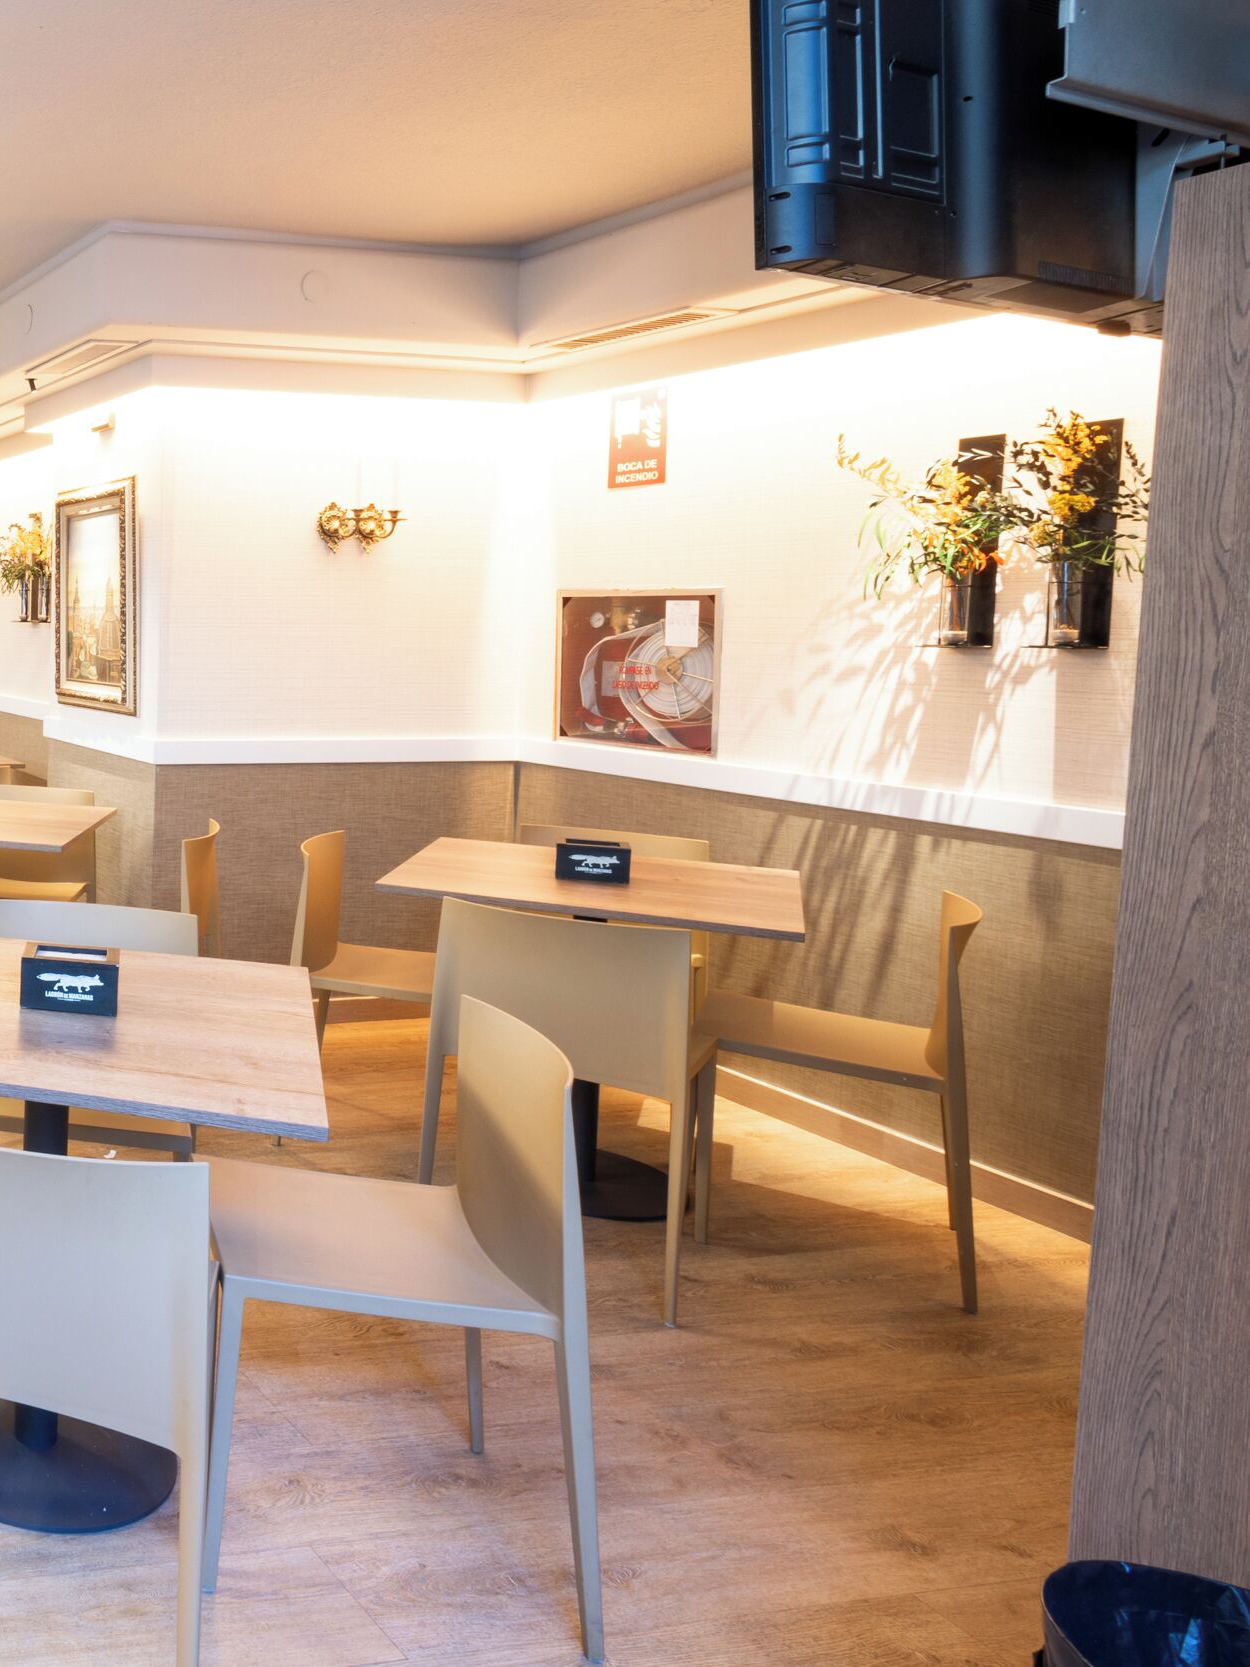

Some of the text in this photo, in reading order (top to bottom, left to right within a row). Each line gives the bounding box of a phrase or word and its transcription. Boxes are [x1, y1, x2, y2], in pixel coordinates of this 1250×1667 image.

[617, 459, 657, 472] BOCA DE
[615, 470, 658, 484] INCENDIO
